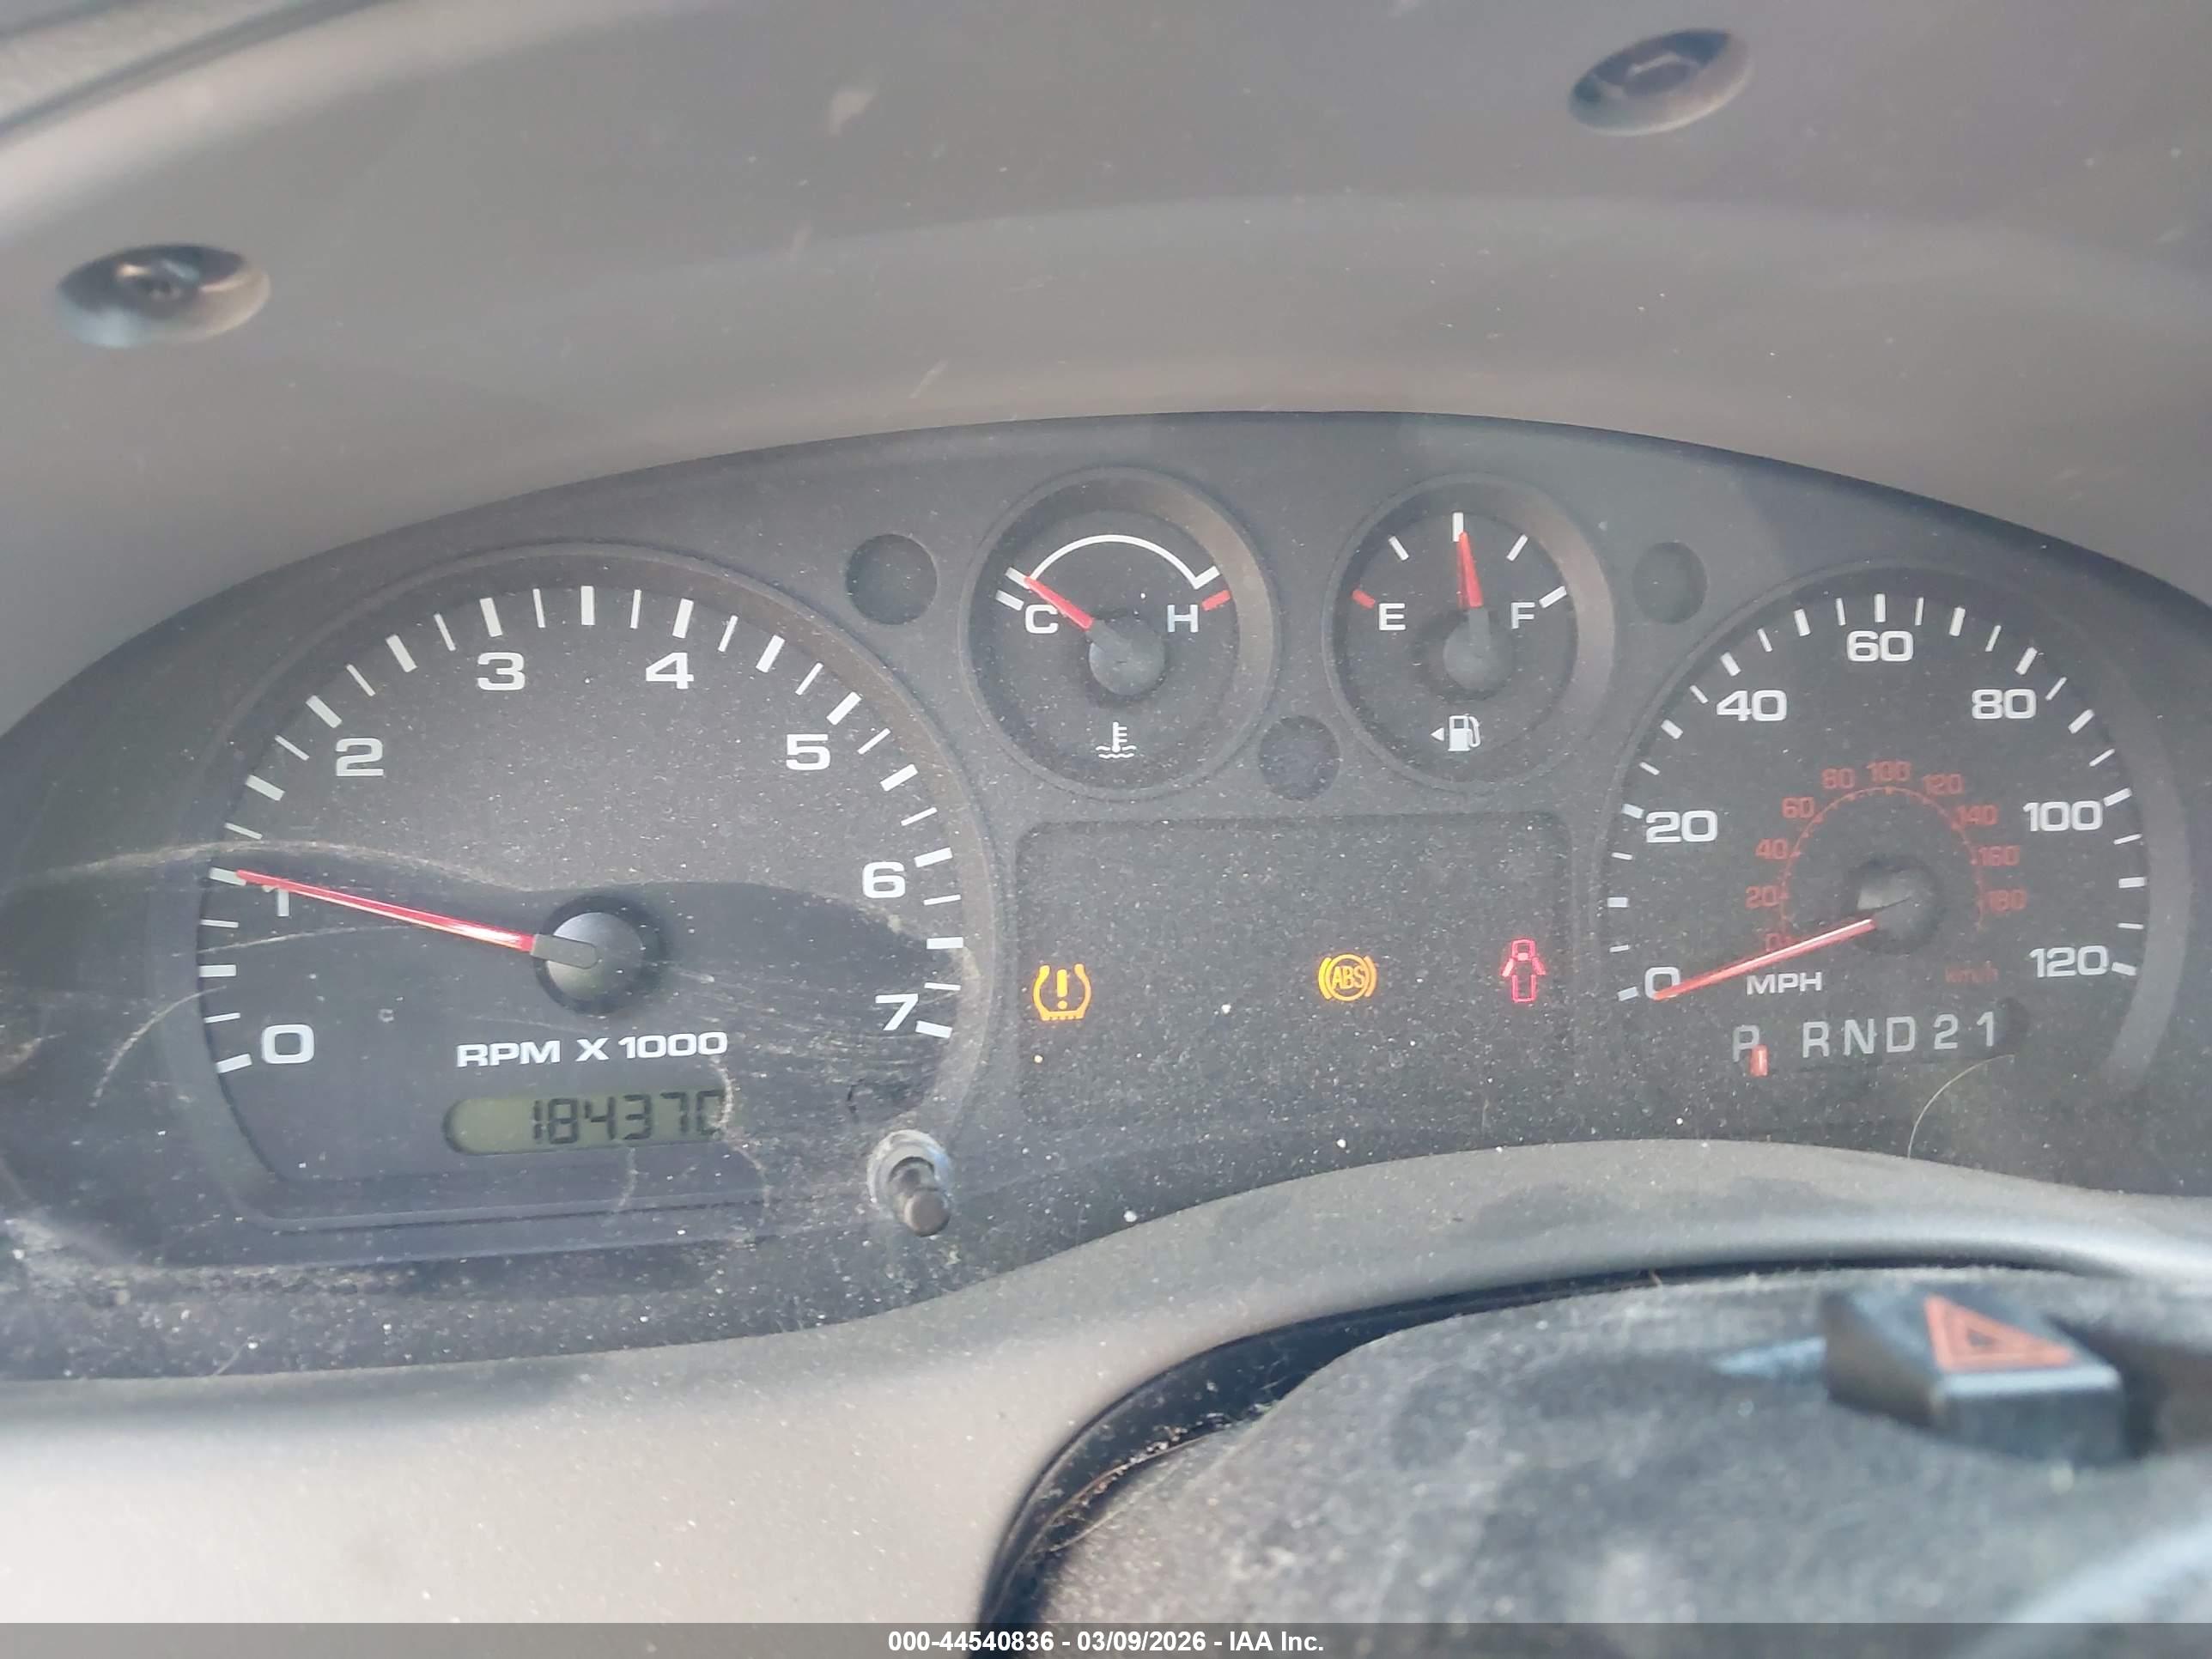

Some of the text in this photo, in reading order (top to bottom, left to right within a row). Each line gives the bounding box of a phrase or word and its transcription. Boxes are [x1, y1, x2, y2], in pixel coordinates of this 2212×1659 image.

[1024, 605, 1059, 634] C
[1167, 604, 1200, 633] H
[1379, 604, 1406, 630] E
[1511, 603, 1535, 629] F
[1847, 630, 1913, 662] 60
[477, 653, 525, 690] 3
[646, 653, 693, 690] 4
[1717, 690, 1787, 721] 40
[1972, 689, 2036, 720] 80
[336, 738, 384, 776] 2
[786, 734, 830, 771] 5
[1821, 768, 1856, 789] 80
[1866, 761, 1911, 782] 100
[1922, 773, 1965, 795] 120
[1781, 797, 1815, 818] 60
[2023, 800, 2103, 831] 100
[1645, 811, 1717, 843] 20
[1755, 838, 1788, 860] 40
[863, 862, 907, 898] 6
[1746, 885, 1779, 908] 20
[2029, 945, 2110, 977] 120
[1331, 965, 1365, 989] ABS
[1644, 967, 1680, 1000] 0
[1747, 971, 1822, 995] MPH
[875, 995, 919, 1030] 7
[262, 1024, 314, 1064] 0
[457, 1032, 728, 1067] RPM X 1000
